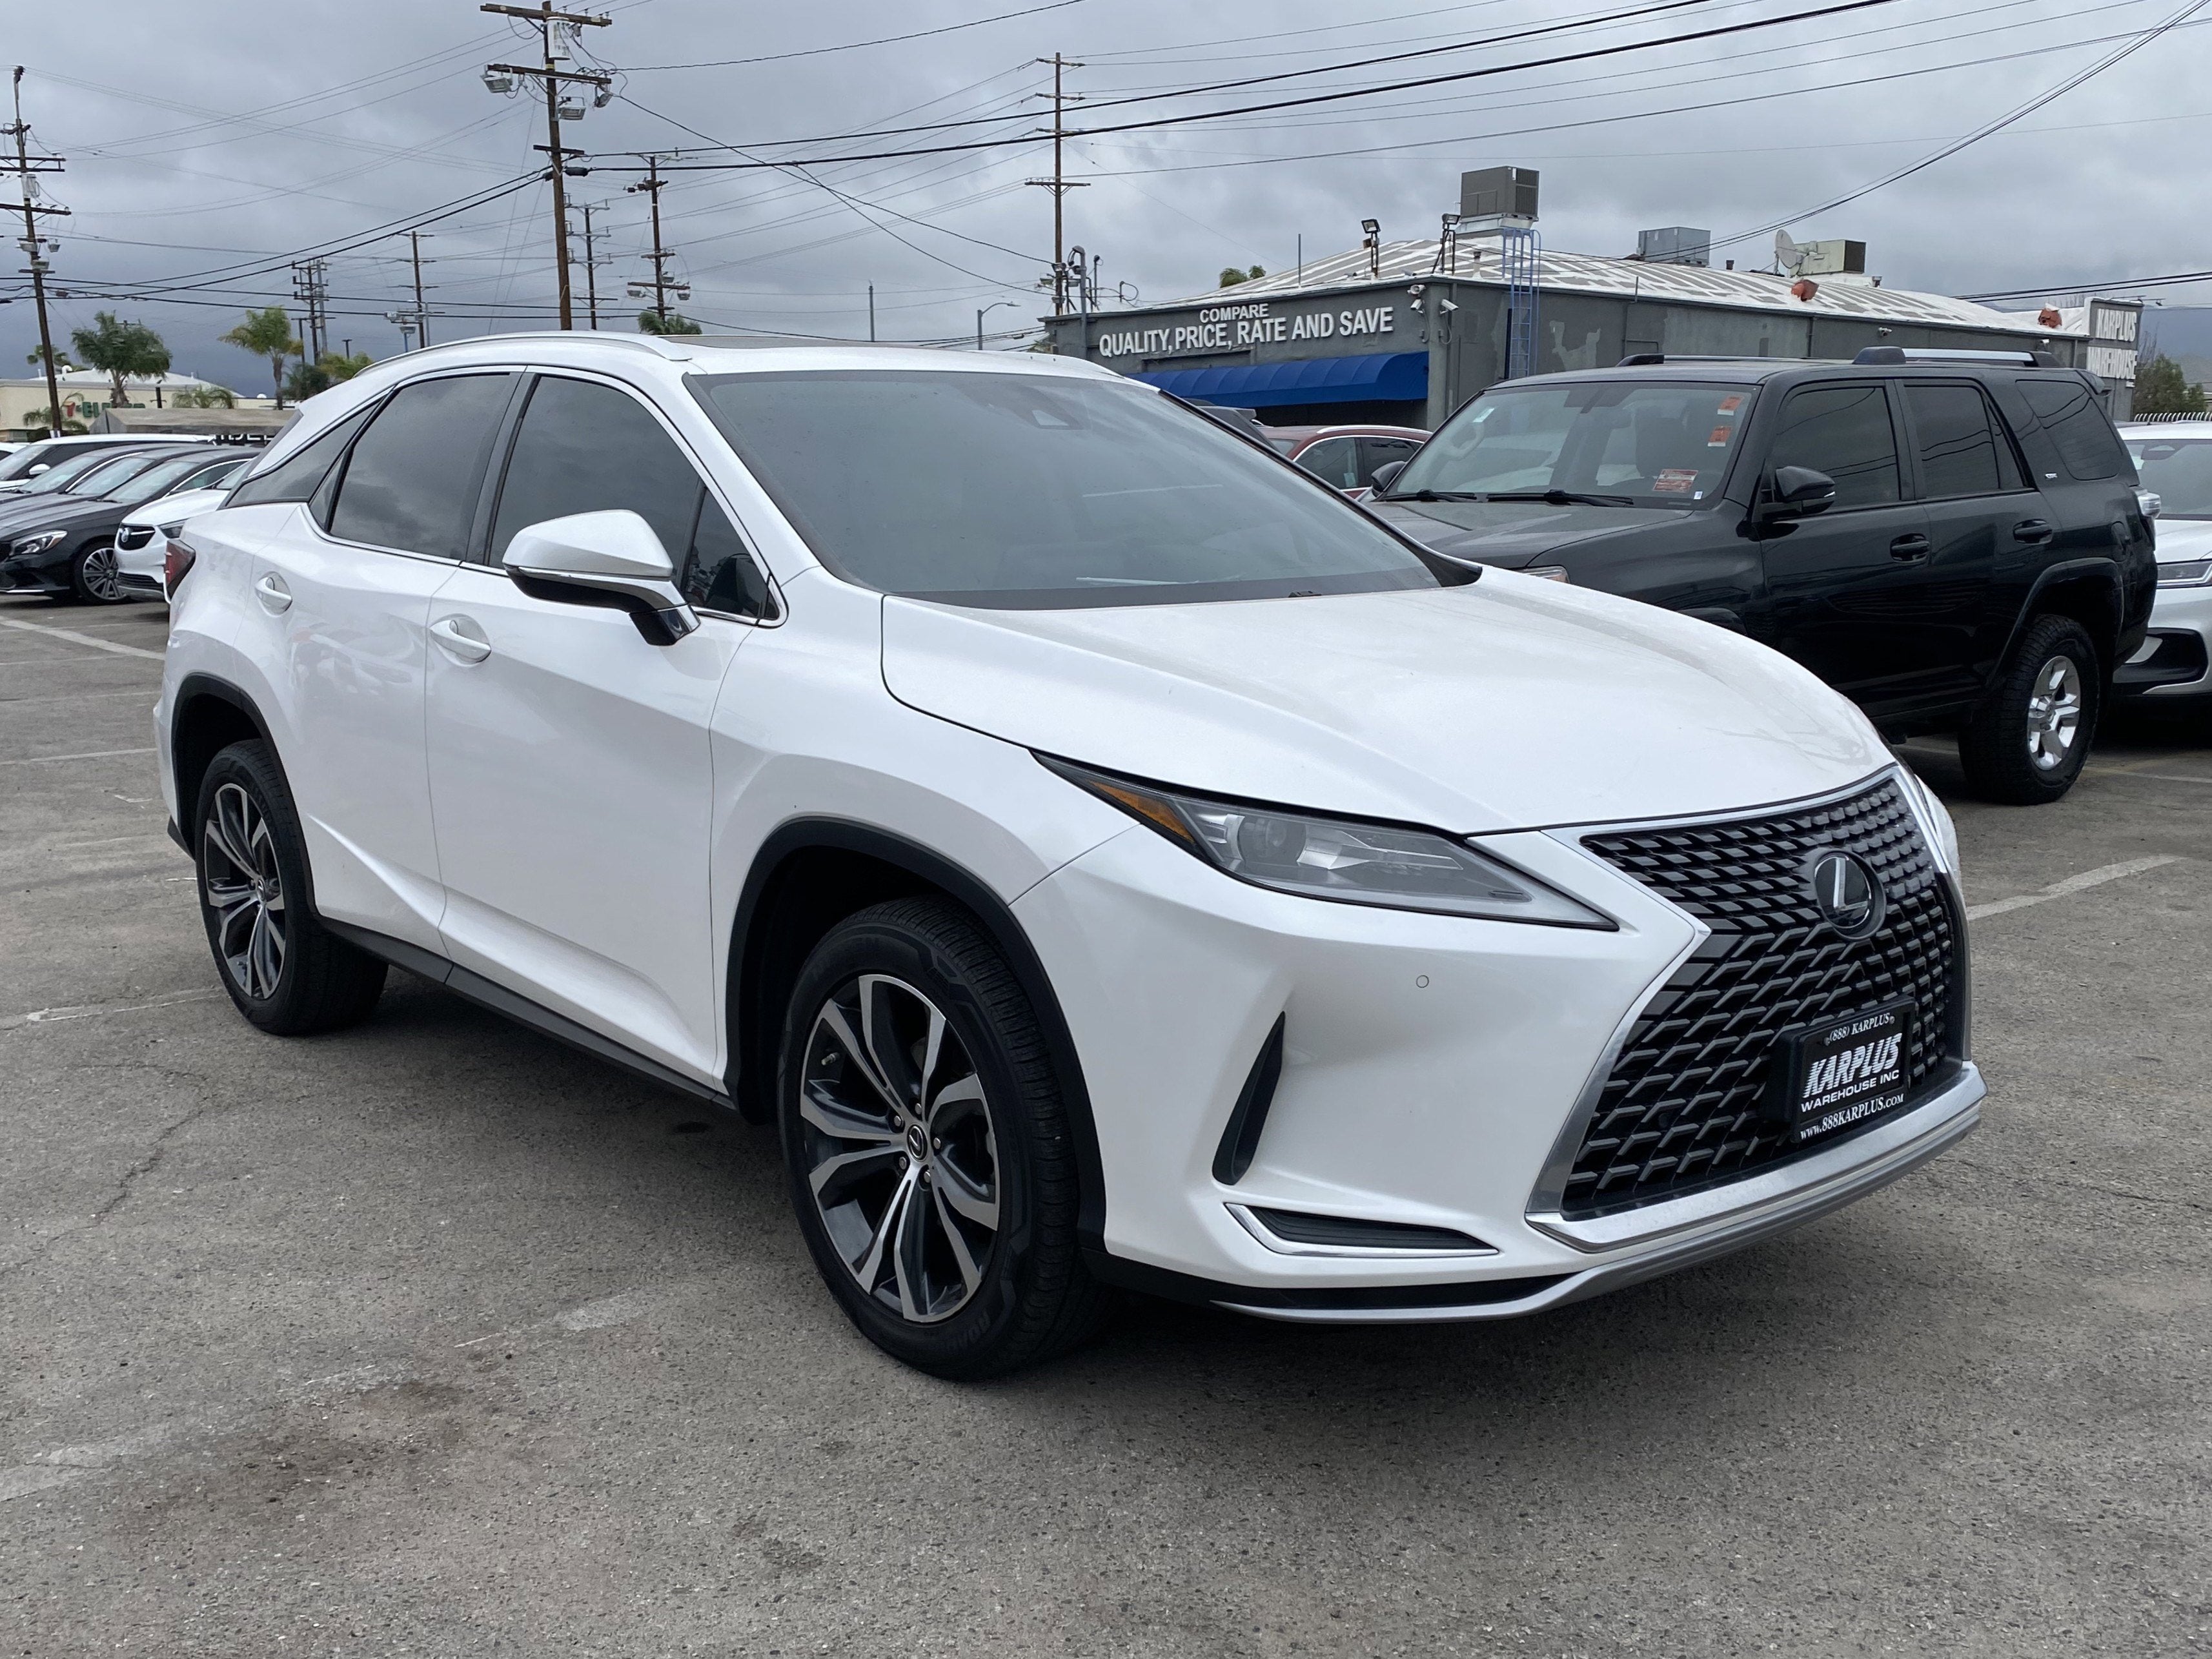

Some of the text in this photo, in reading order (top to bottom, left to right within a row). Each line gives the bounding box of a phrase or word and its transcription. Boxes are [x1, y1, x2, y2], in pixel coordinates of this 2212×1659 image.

[1199, 303, 1269, 323] COMPARE
[2096, 309, 2136, 341] KARPLUS
[1099, 307, 1394, 357] QUALITY, PRICE, RATE AND SAVE
[2086, 347, 2138, 379] WAREHOUSE
[1829, 1012, 1891, 1042] (888) KARPLUS
[1803, 1032, 1903, 1098] KARPLUS
[1800, 1069, 1900, 1112] WAREHOUSE INC
